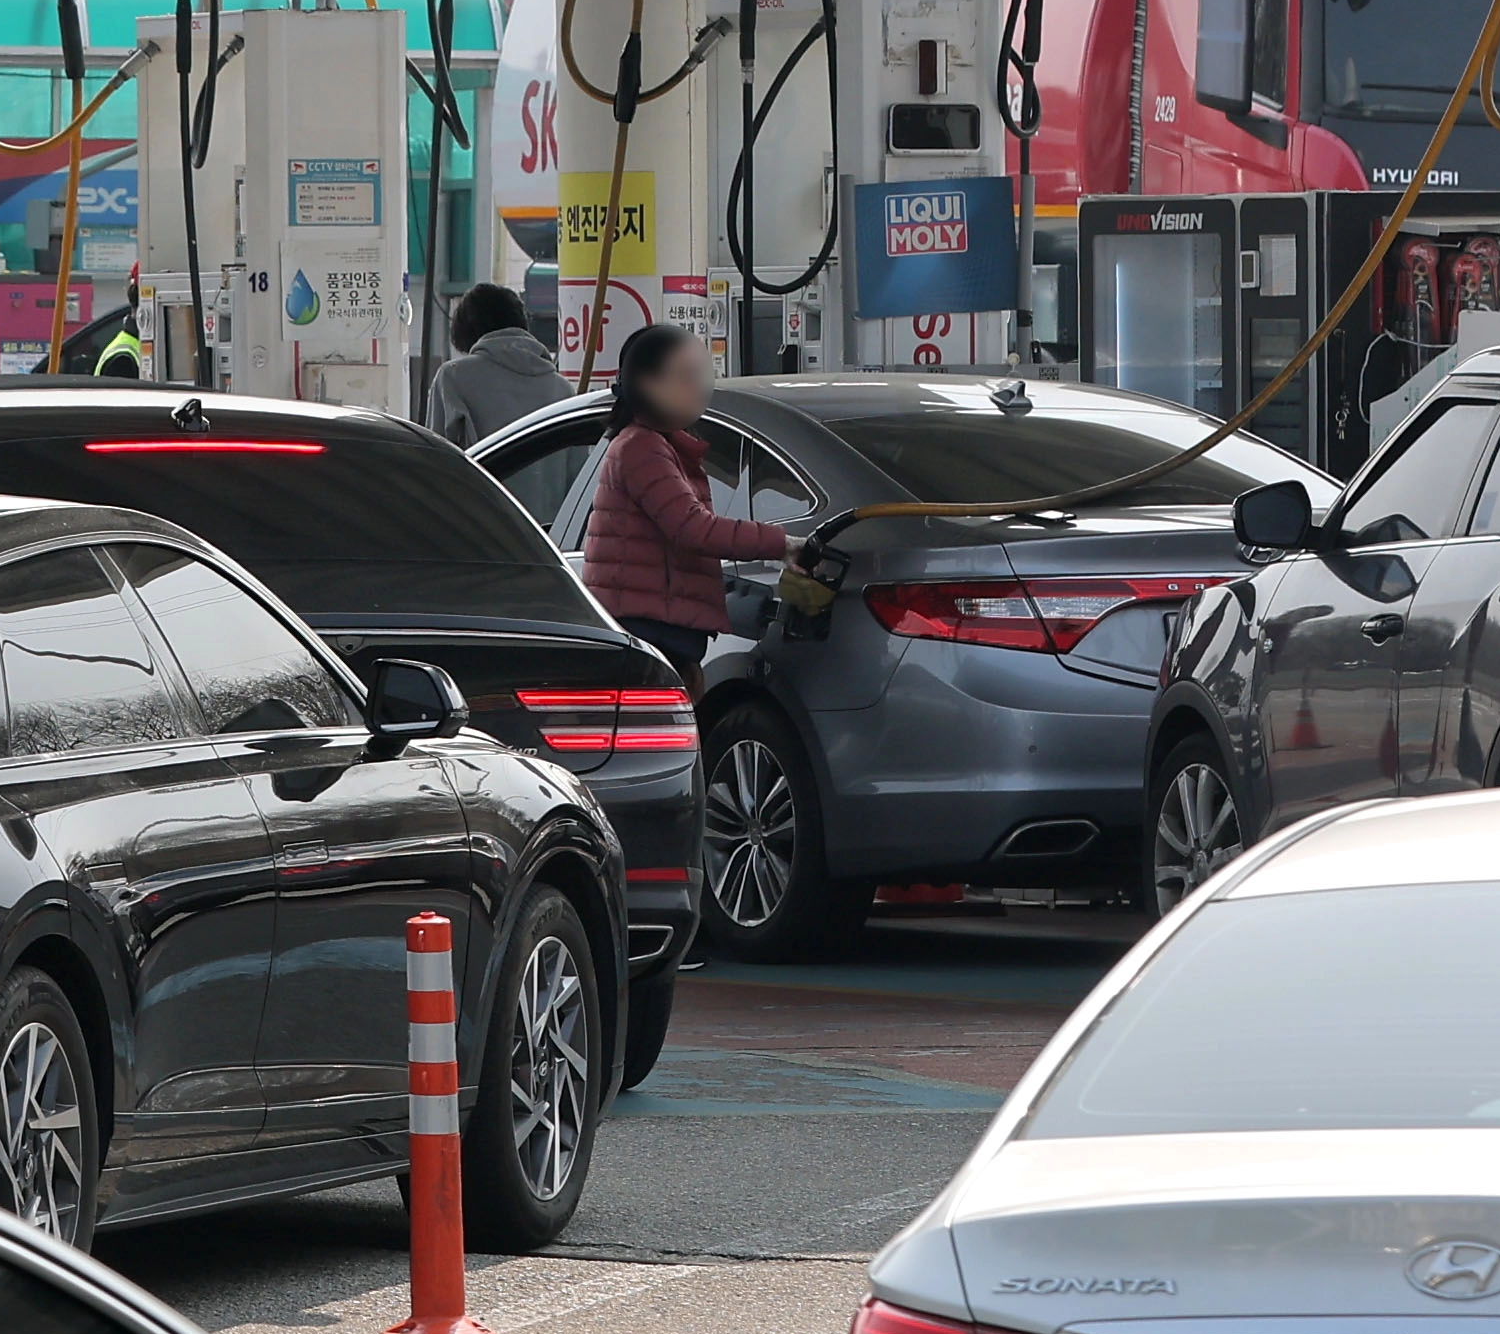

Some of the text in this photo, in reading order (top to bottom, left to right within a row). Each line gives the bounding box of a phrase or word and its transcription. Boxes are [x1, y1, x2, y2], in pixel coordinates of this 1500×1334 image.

[1154, 95, 1176, 123] 2429
[307, 162, 332, 172] CCTV
[1372, 167, 1459, 186] HYUDAI
[888, 194, 963, 225] LIQUI
[889, 223, 964, 253] MOLY
[248, 271, 269, 294] 18
[325, 271, 382, 290] 품질인증
[668, 306, 708, 320] 신용(체크)
[558, 303, 612, 354] elf
[992, 1276, 1178, 1297] SONATA
